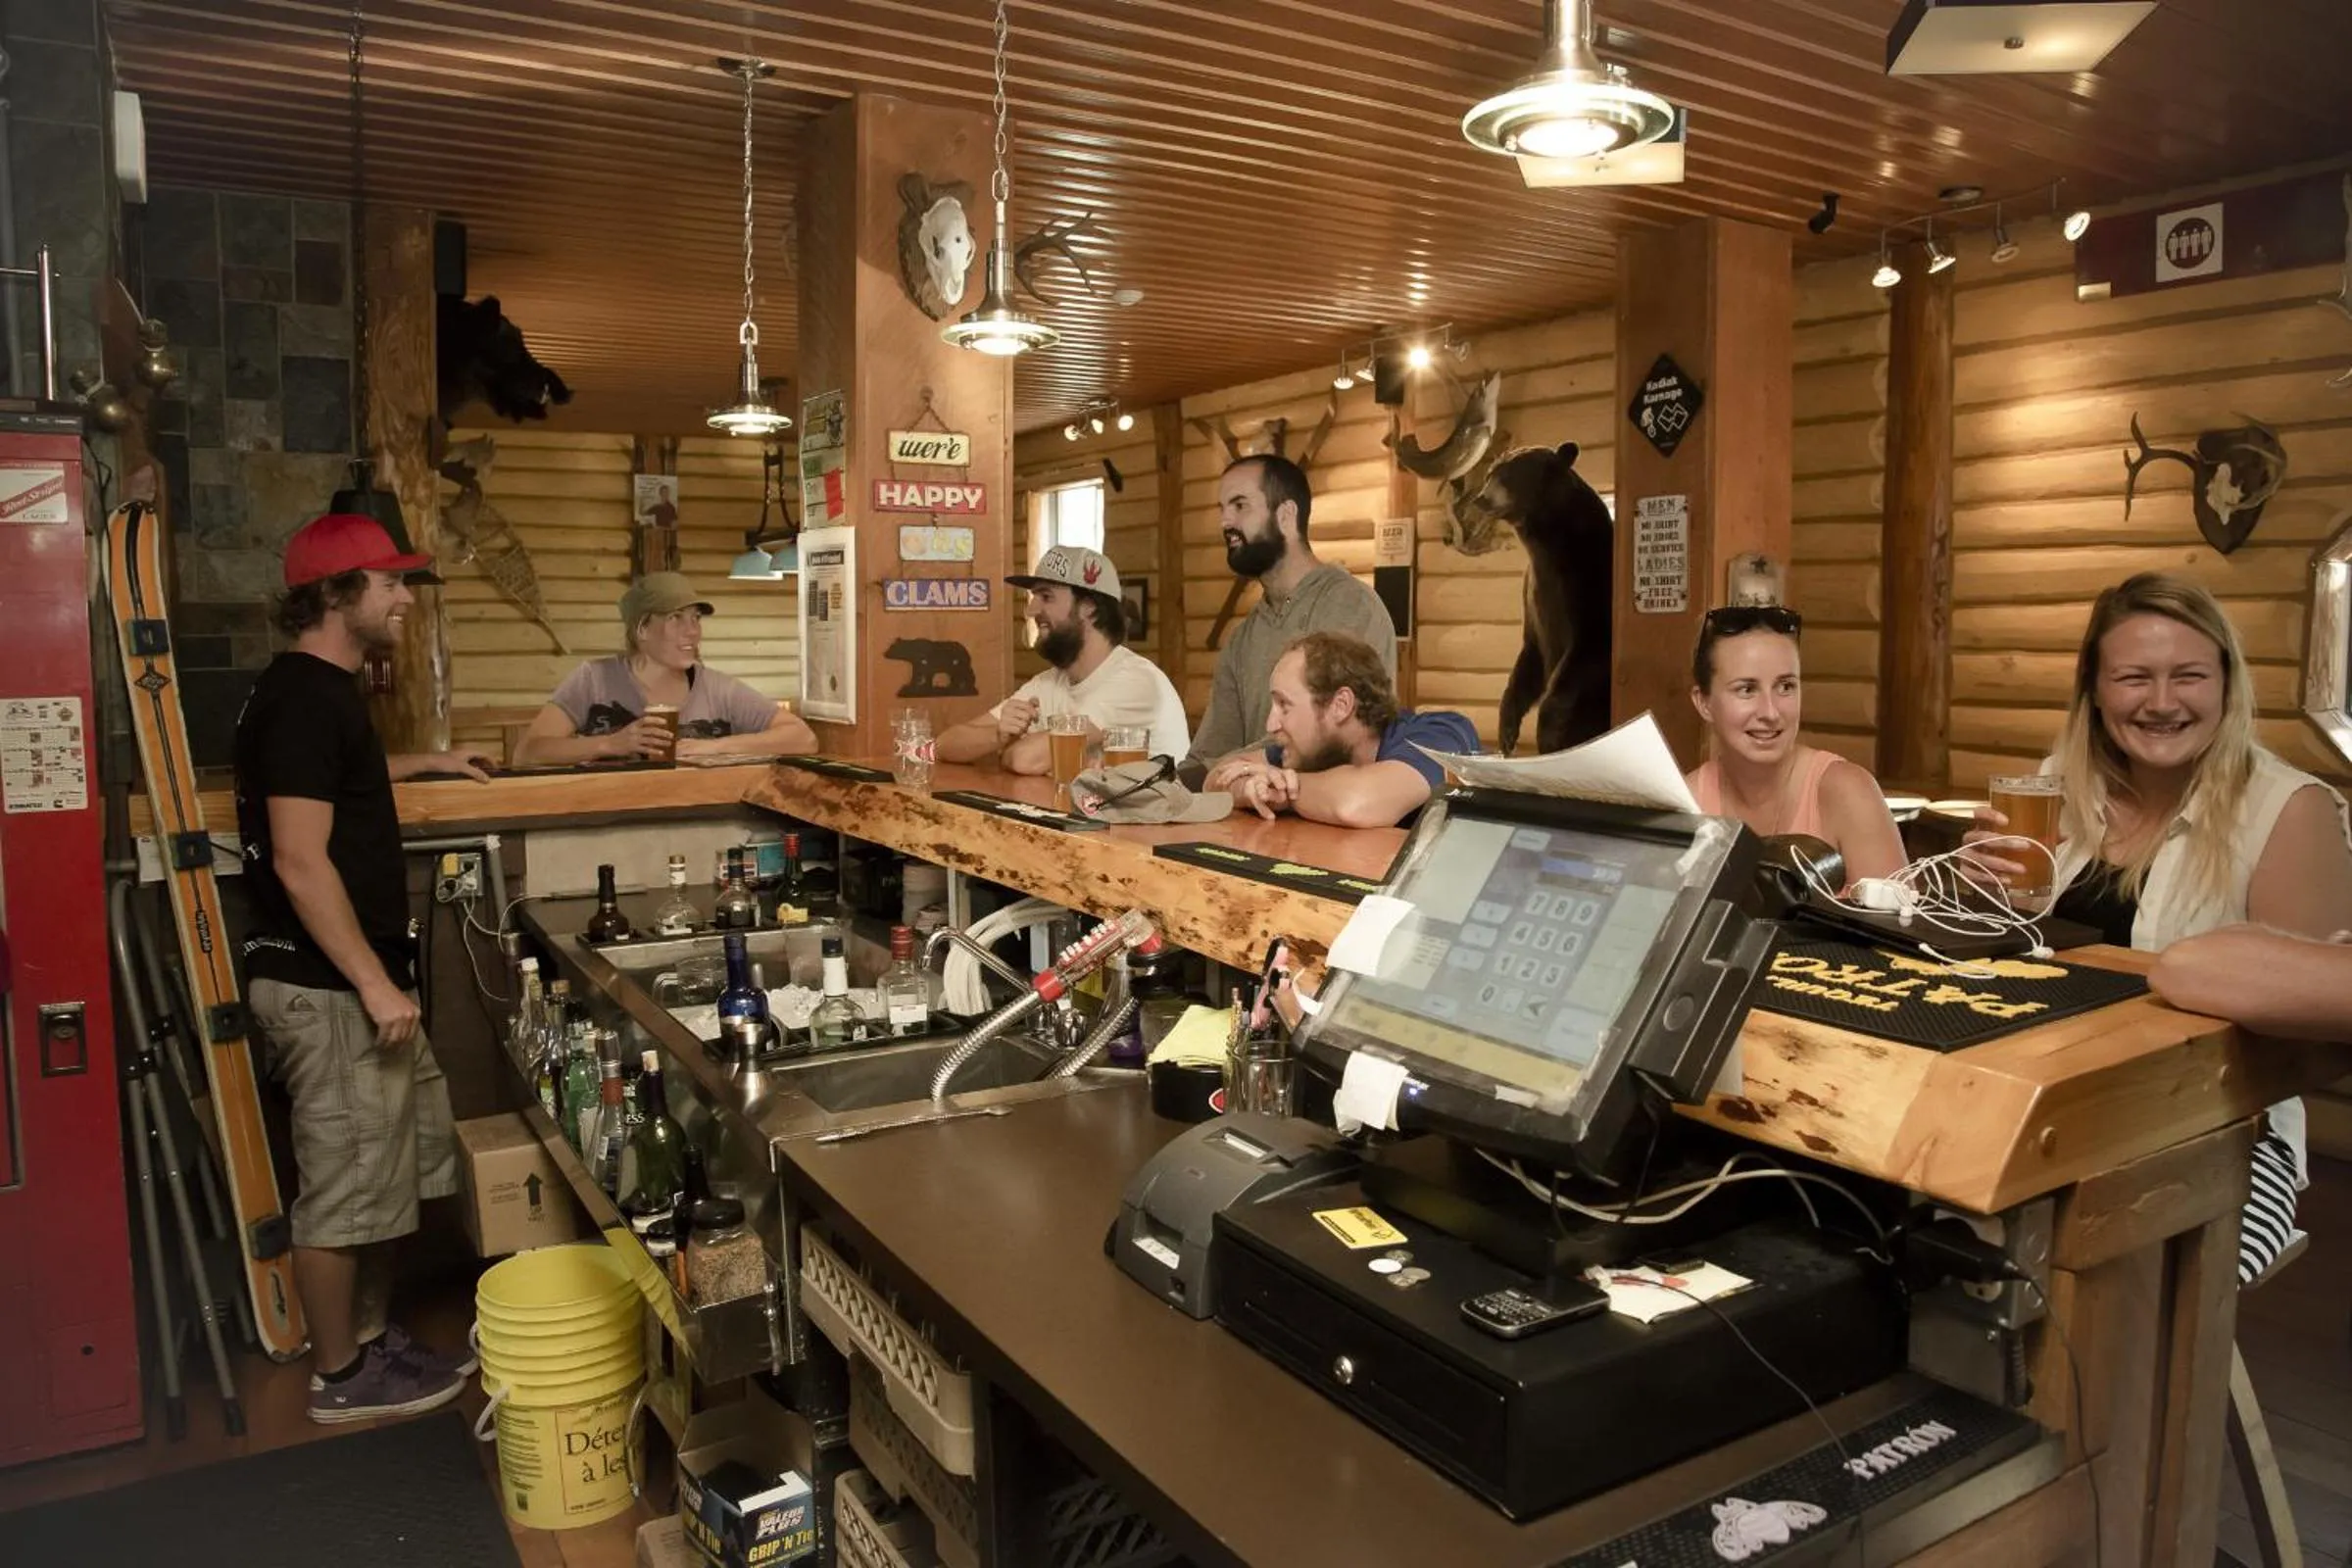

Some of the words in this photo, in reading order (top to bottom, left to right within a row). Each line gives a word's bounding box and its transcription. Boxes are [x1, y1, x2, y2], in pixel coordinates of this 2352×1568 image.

[878, 483, 983, 510] HAPPY
[886, 580, 988, 607] CLAMS
[1531, 894, 1545, 910] 7
[1554, 900, 1568, 916] 8
[1579, 905, 1593, 922] 9
[1515, 925, 1529, 941] 4
[1538, 930, 1553, 948] 5
[1563, 935, 1578, 953] 6
[1499, 955, 1511, 972] 1
[1520, 960, 1536, 978] 2
[1481, 985, 1494, 1003] 0
[581, 1461, 596, 1483] à
[749, 1539, 780, 1563] GRIP
